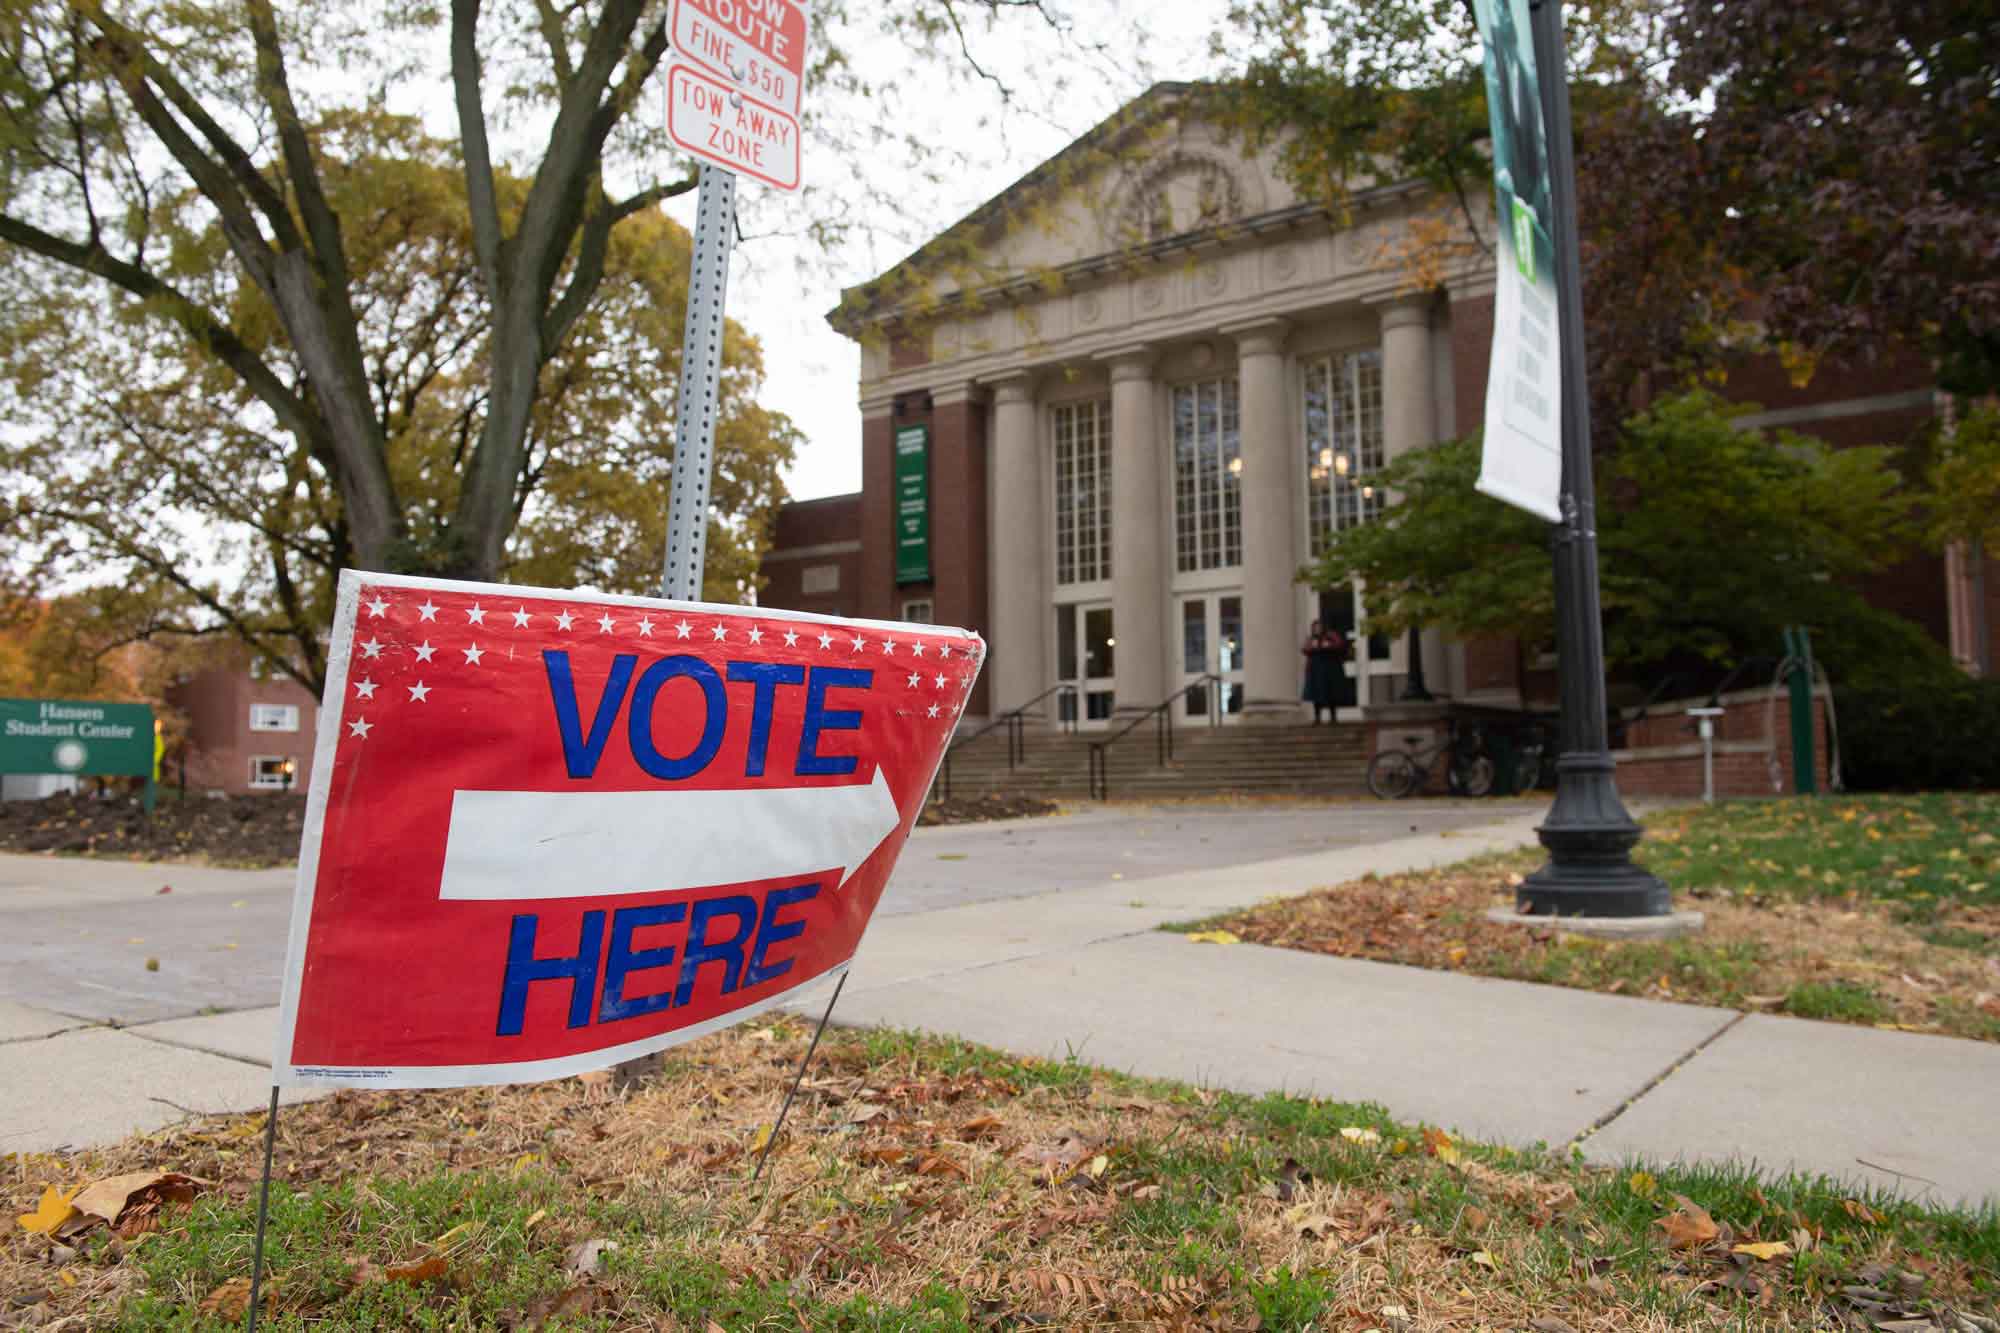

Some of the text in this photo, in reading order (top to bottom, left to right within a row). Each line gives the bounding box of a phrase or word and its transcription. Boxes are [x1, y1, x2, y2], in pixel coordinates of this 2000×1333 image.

[691, 20, 784, 100] FINE $50
[680, 78, 789, 147] TOW AWAY
[708, 123, 764, 167] ZONE
[5, 719, 135, 738] Student Center
[40, 702, 104, 720] Hansen
[542, 649, 874, 780] VOTE
[495, 884, 821, 1037] HERE
